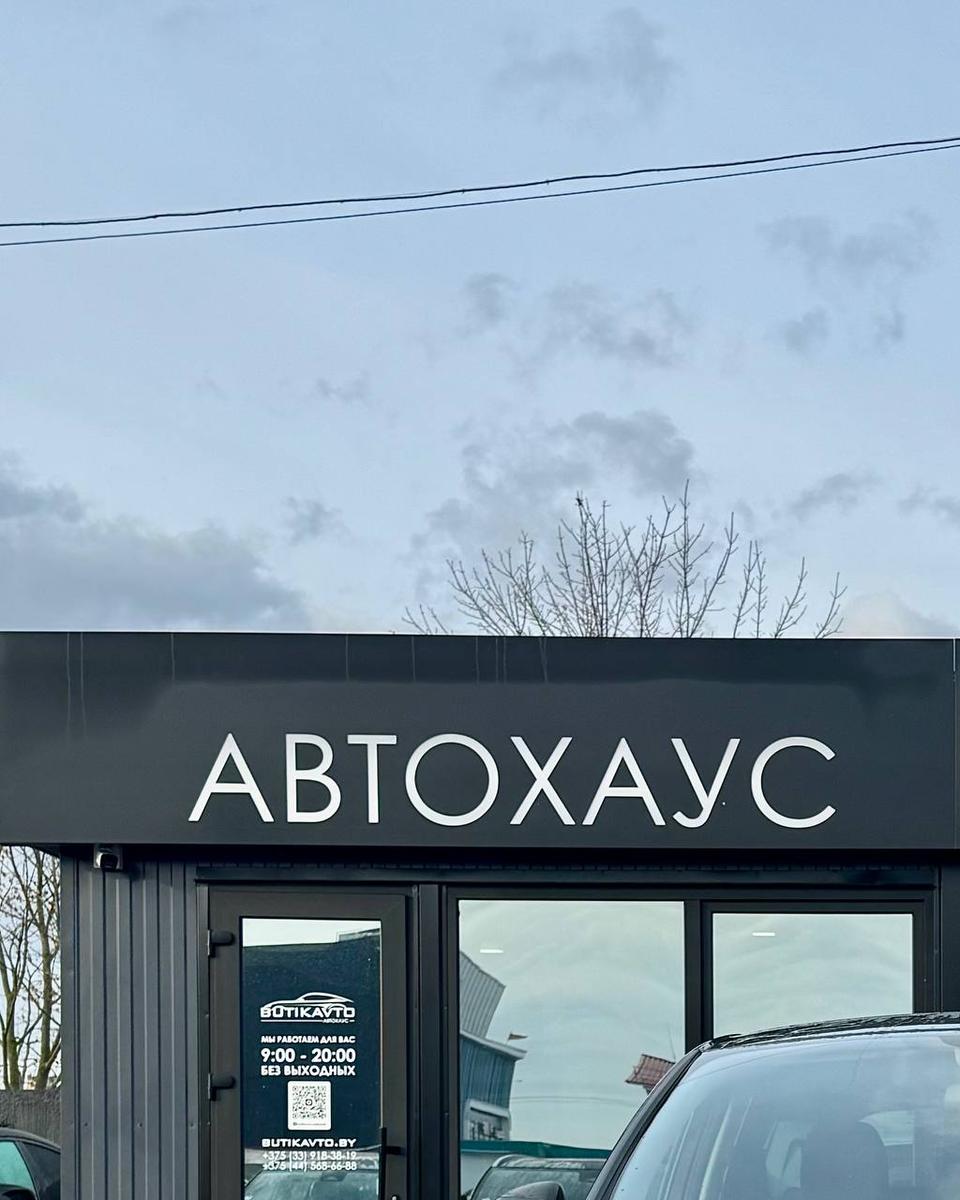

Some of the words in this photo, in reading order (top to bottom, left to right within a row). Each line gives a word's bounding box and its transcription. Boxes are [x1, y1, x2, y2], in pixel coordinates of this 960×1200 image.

[189, 732, 837, 830] АВТОХАУС
[260, 1006, 356, 1018] BUTIKAVTO
[261, 1035, 276, 1043] МЫ
[277, 1035, 320, 1043] РАБОТАЕМ
[320, 1035, 337, 1044] ДЛЯ
[338, 1035, 356, 1043] ВАС
[261, 1048, 296, 1063] 9:00
[311, 1048, 356, 1062] 20:00
[261, 1065, 281, 1076] БЕЗ
[284, 1065, 356, 1077] ВЫХОДНЫХ
[261, 1138, 357, 1148] BUTIKAVTO.BY
[262, 1151, 287, 1161] +375
[289, 1150, 307, 1162] (33)
[310, 1151, 357, 1161] 918-38-19
[262, 1161, 287, 1171] +375
[289, 1160, 307, 1172] (44)
[310, 1161, 357, 1171] 568-66-88
